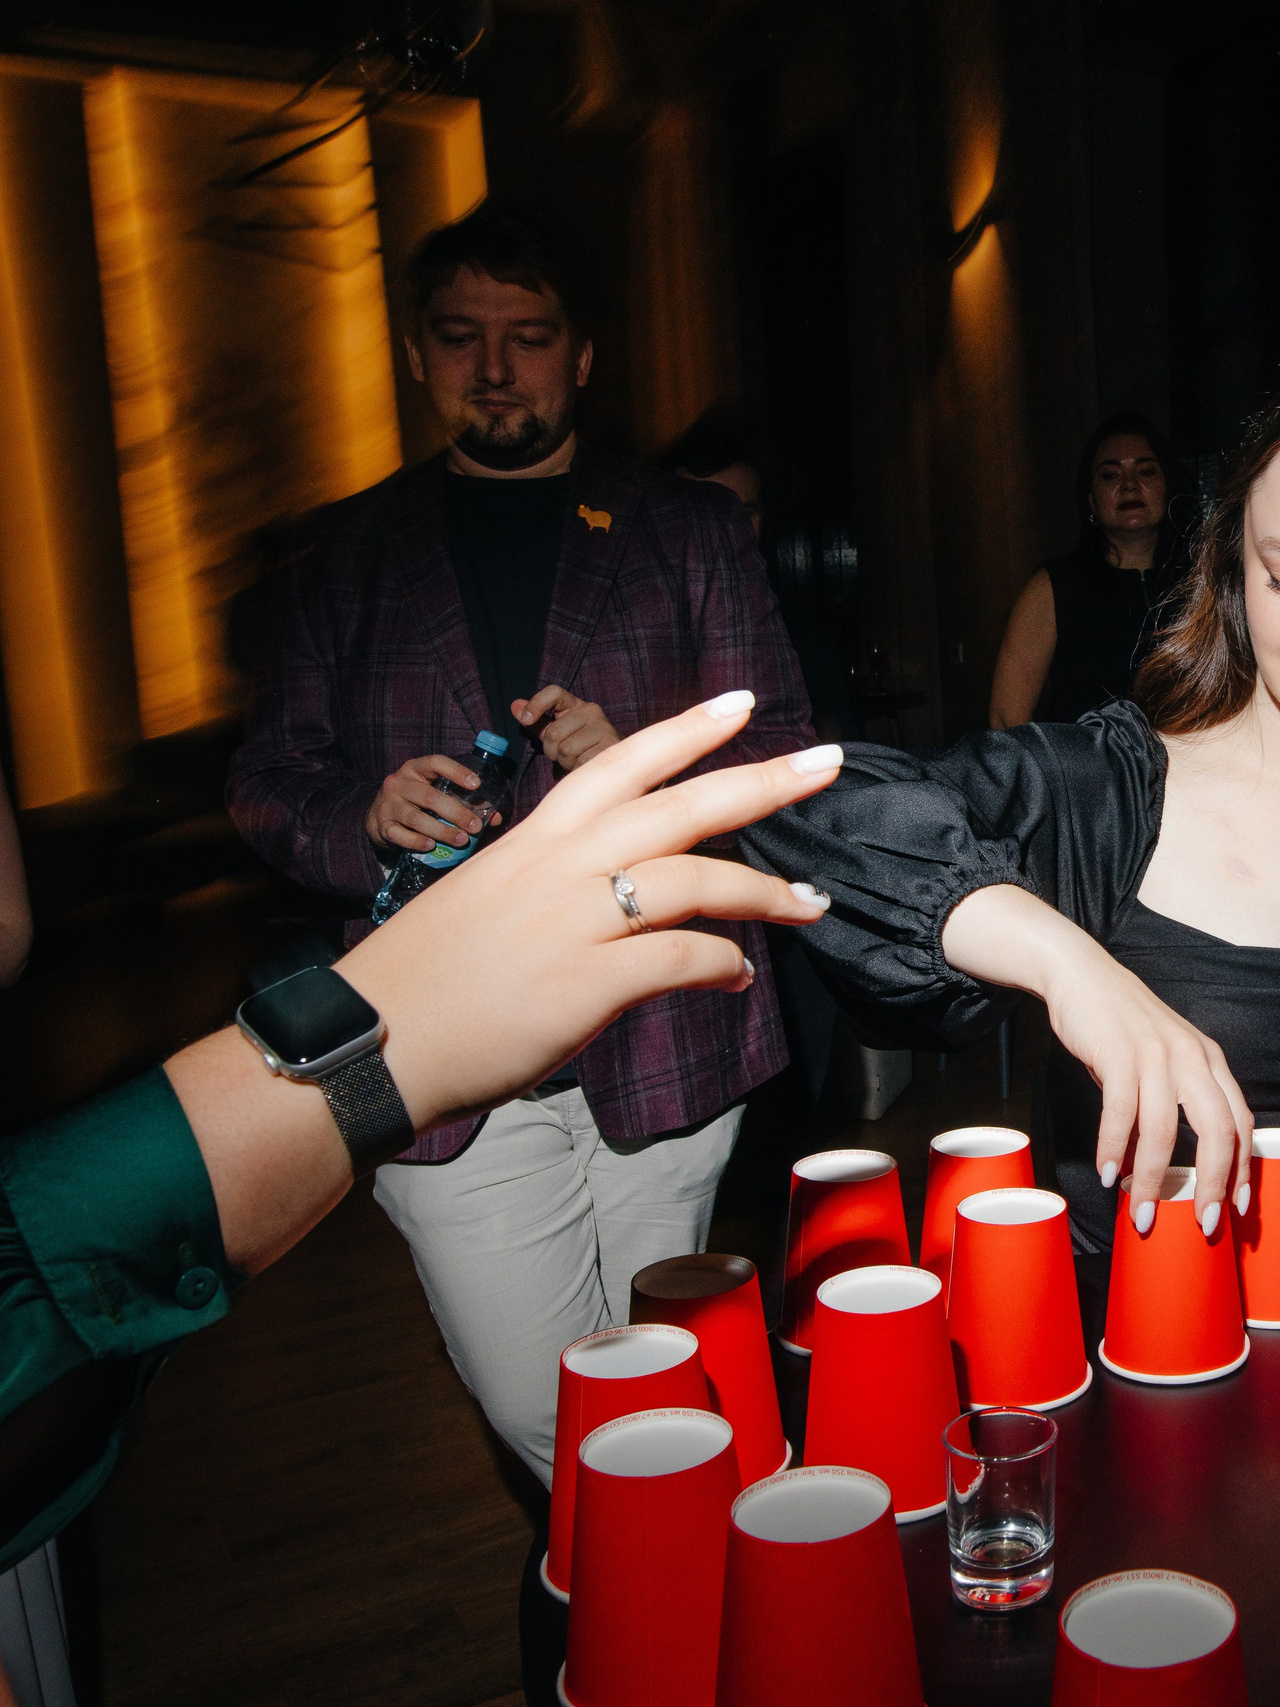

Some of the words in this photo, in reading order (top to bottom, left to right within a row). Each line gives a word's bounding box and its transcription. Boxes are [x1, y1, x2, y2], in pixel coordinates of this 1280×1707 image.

[604, 1327, 637, 1337] 551-96-08
[622, 1414, 640, 1424] (800)
[768, 1474, 787, 1484] (800)
[1101, 1573, 1141, 1586] 551-96-08
